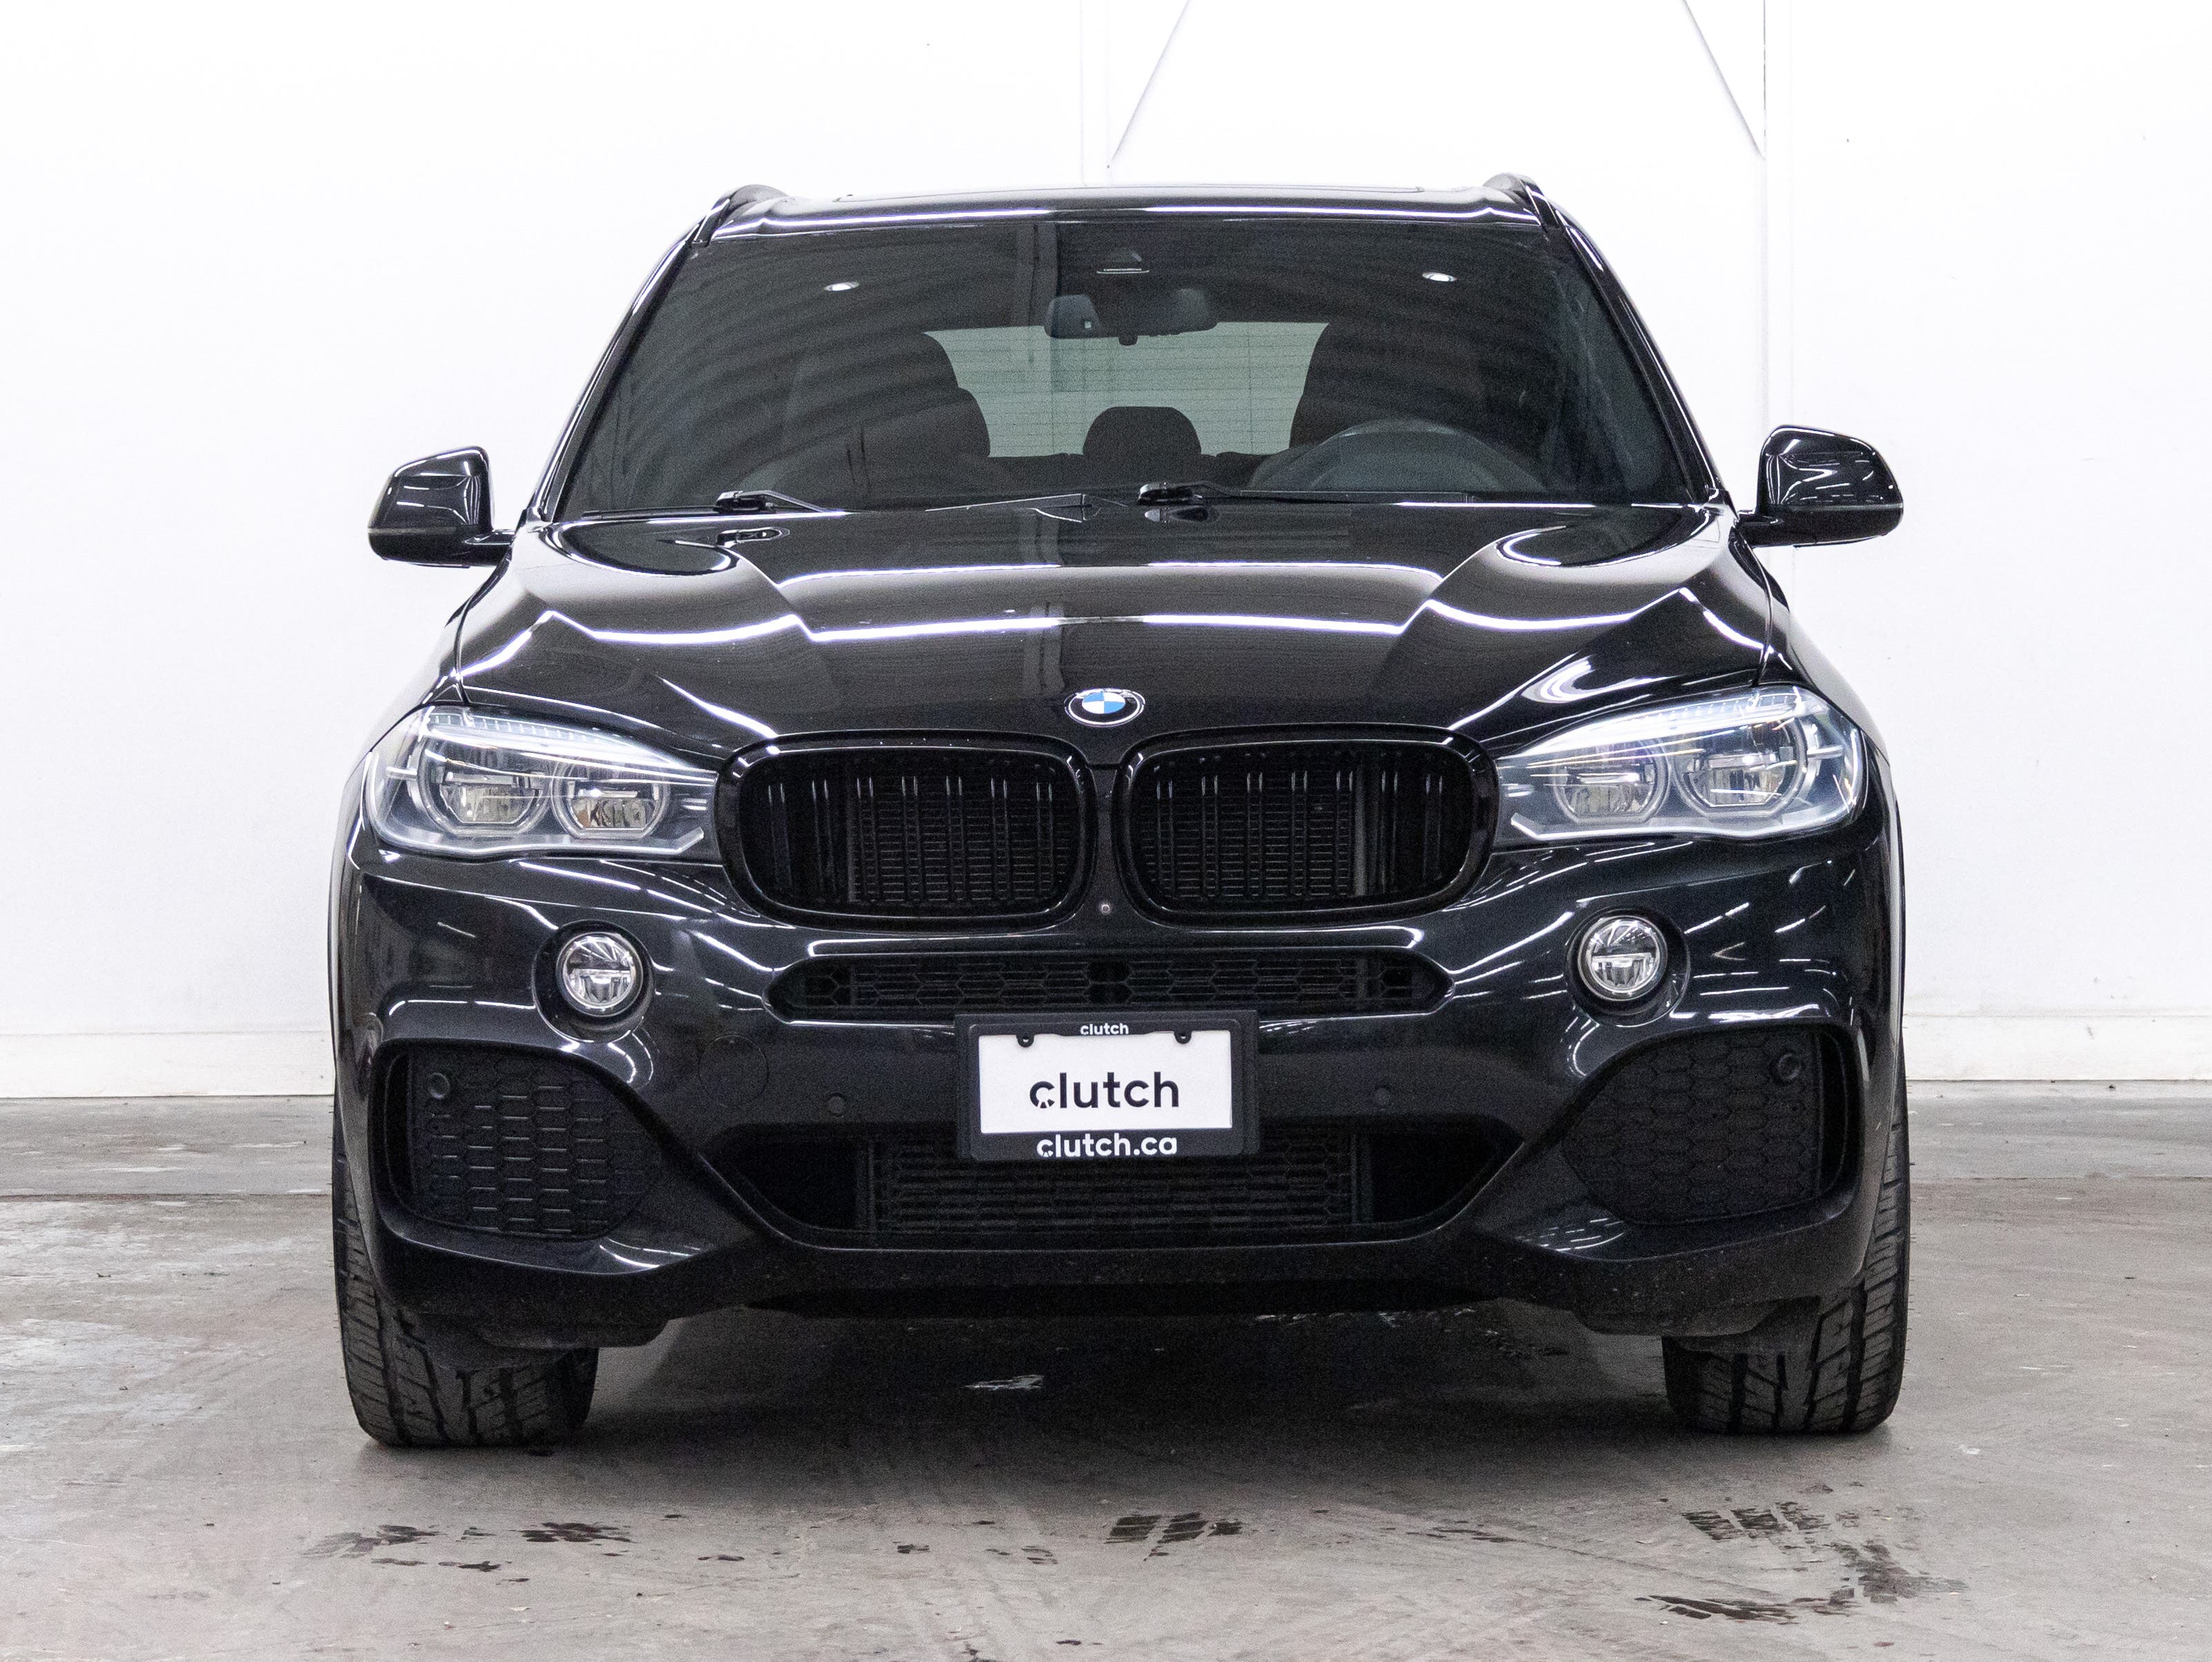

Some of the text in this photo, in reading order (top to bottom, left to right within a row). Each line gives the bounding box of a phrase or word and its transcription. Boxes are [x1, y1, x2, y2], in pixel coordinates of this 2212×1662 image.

[1080, 1022, 1129, 1035] clutch
[1029, 1071, 1180, 1109] clutch
[1036, 1133, 1178, 1158] clutch.ca
